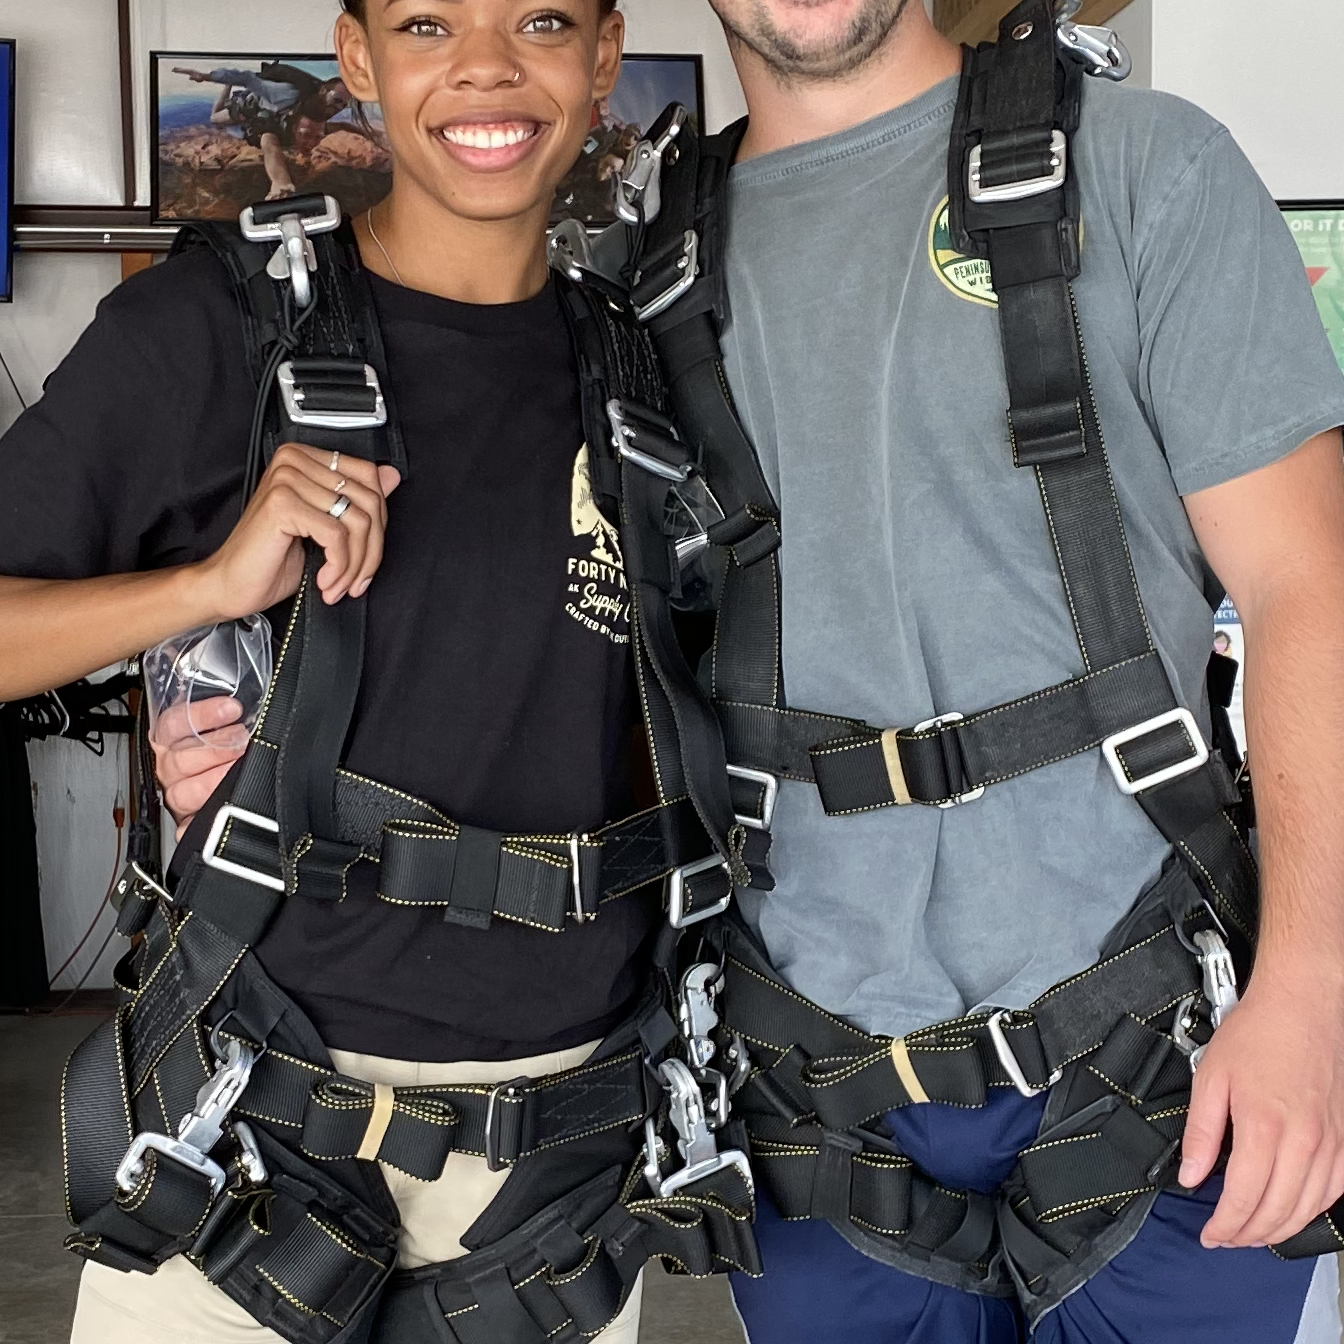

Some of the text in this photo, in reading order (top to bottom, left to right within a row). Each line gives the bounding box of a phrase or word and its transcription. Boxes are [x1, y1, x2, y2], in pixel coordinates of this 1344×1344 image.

[1290, 219, 1314, 233] OR
[1318, 219, 1333, 232] IT
[567, 557, 617, 583] FORTY
[580, 582, 623, 622] Supply
[565, 602, 600, 632] CRAFTED
[599, 624, 611, 637] BY
